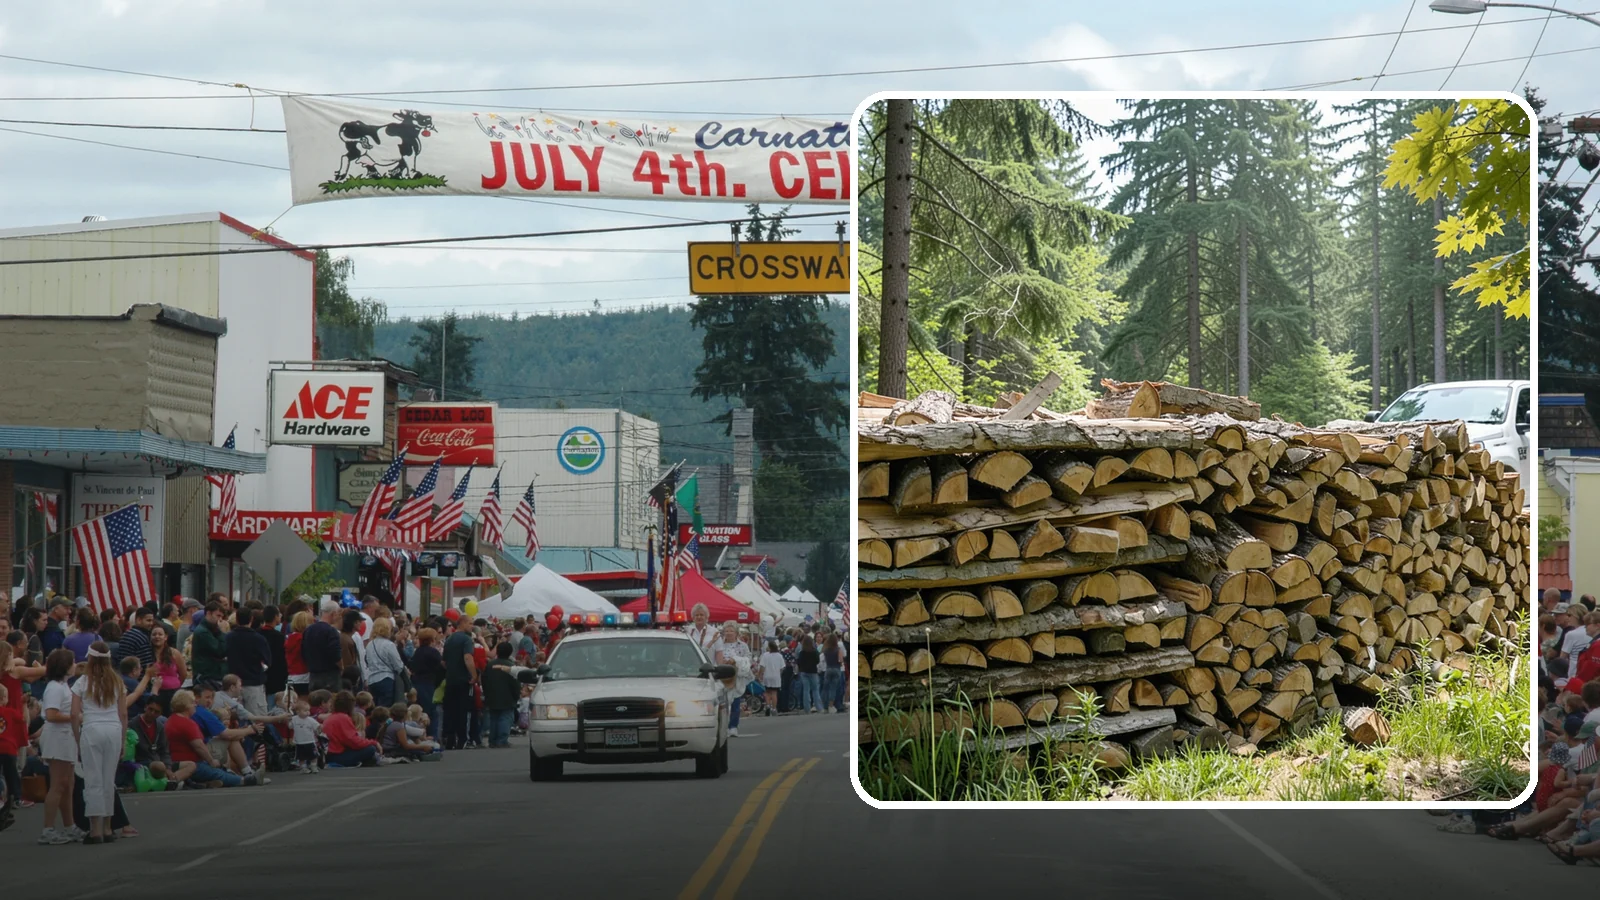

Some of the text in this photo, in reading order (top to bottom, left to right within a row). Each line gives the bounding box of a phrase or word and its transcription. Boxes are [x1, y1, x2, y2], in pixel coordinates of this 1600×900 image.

[695, 121, 850, 150] Carnat
[481, 141, 604, 192] JULY
[632, 150, 746, 198] 4th.
[697, 254, 850, 280] CROSSWA
[282, 380, 374, 420] ACE
[406, 409, 452, 422] CEDAR
[283, 421, 370, 436] Hardware
[416, 428, 477, 447] Coca-Cola
[354, 467, 387, 481] Simpl
[83, 485, 155, 495] St. Vincent de Paul
[688, 526, 741, 535] CRNATION
[699, 535, 730, 543] GLASS
